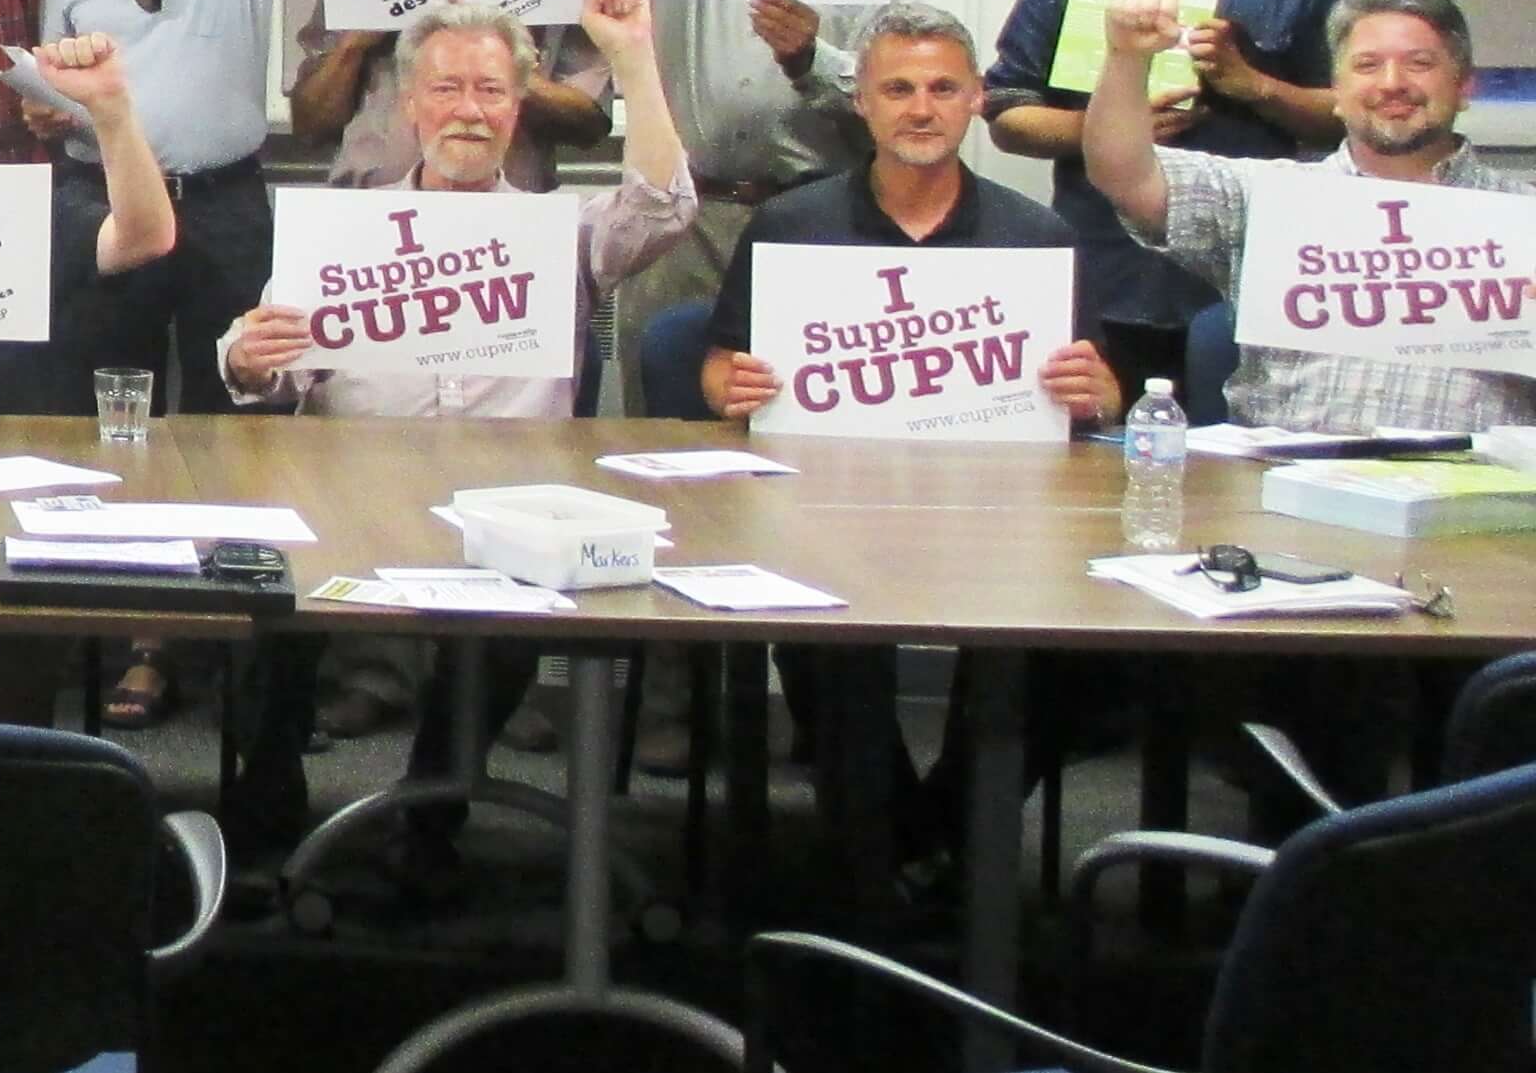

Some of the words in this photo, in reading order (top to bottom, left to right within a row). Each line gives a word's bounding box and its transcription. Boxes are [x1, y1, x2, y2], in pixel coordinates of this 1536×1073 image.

[388, 208, 424, 256] I
[1377, 200, 1413, 244] I
[320, 238, 511, 297] Support
[1297, 238, 1505, 279] Support
[310, 272, 535, 349] CUPW
[877, 266, 915, 314] I
[1284, 278, 1532, 329] CUPW
[803, 295, 1005, 355] Support
[416, 339, 540, 367] www.cupw.ca
[794, 330, 1030, 413] CUPW
[905, 400, 1035, 433] www.cupw.ca
